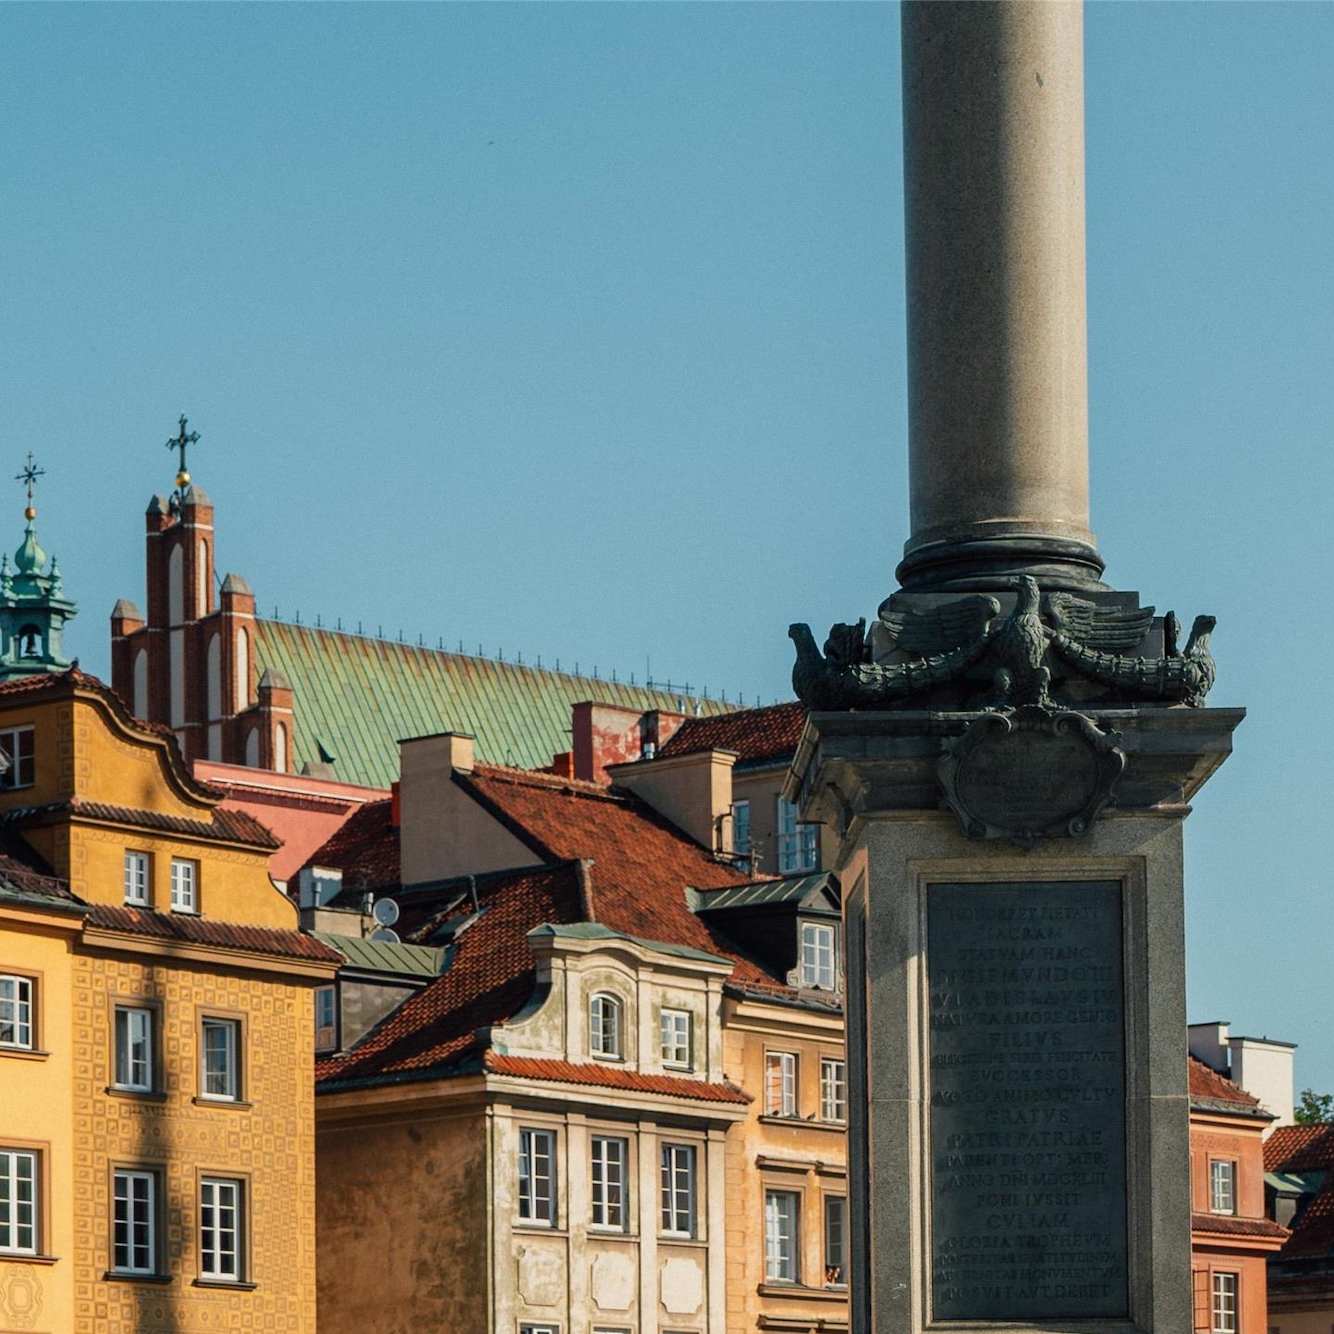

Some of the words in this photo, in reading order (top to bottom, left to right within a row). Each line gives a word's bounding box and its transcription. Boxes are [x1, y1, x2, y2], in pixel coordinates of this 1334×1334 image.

[989, 1031, 1063, 1047] FILIVS
[985, 1107, 1069, 1125] GRATVS
[977, 1194, 1019, 1207] PONI
